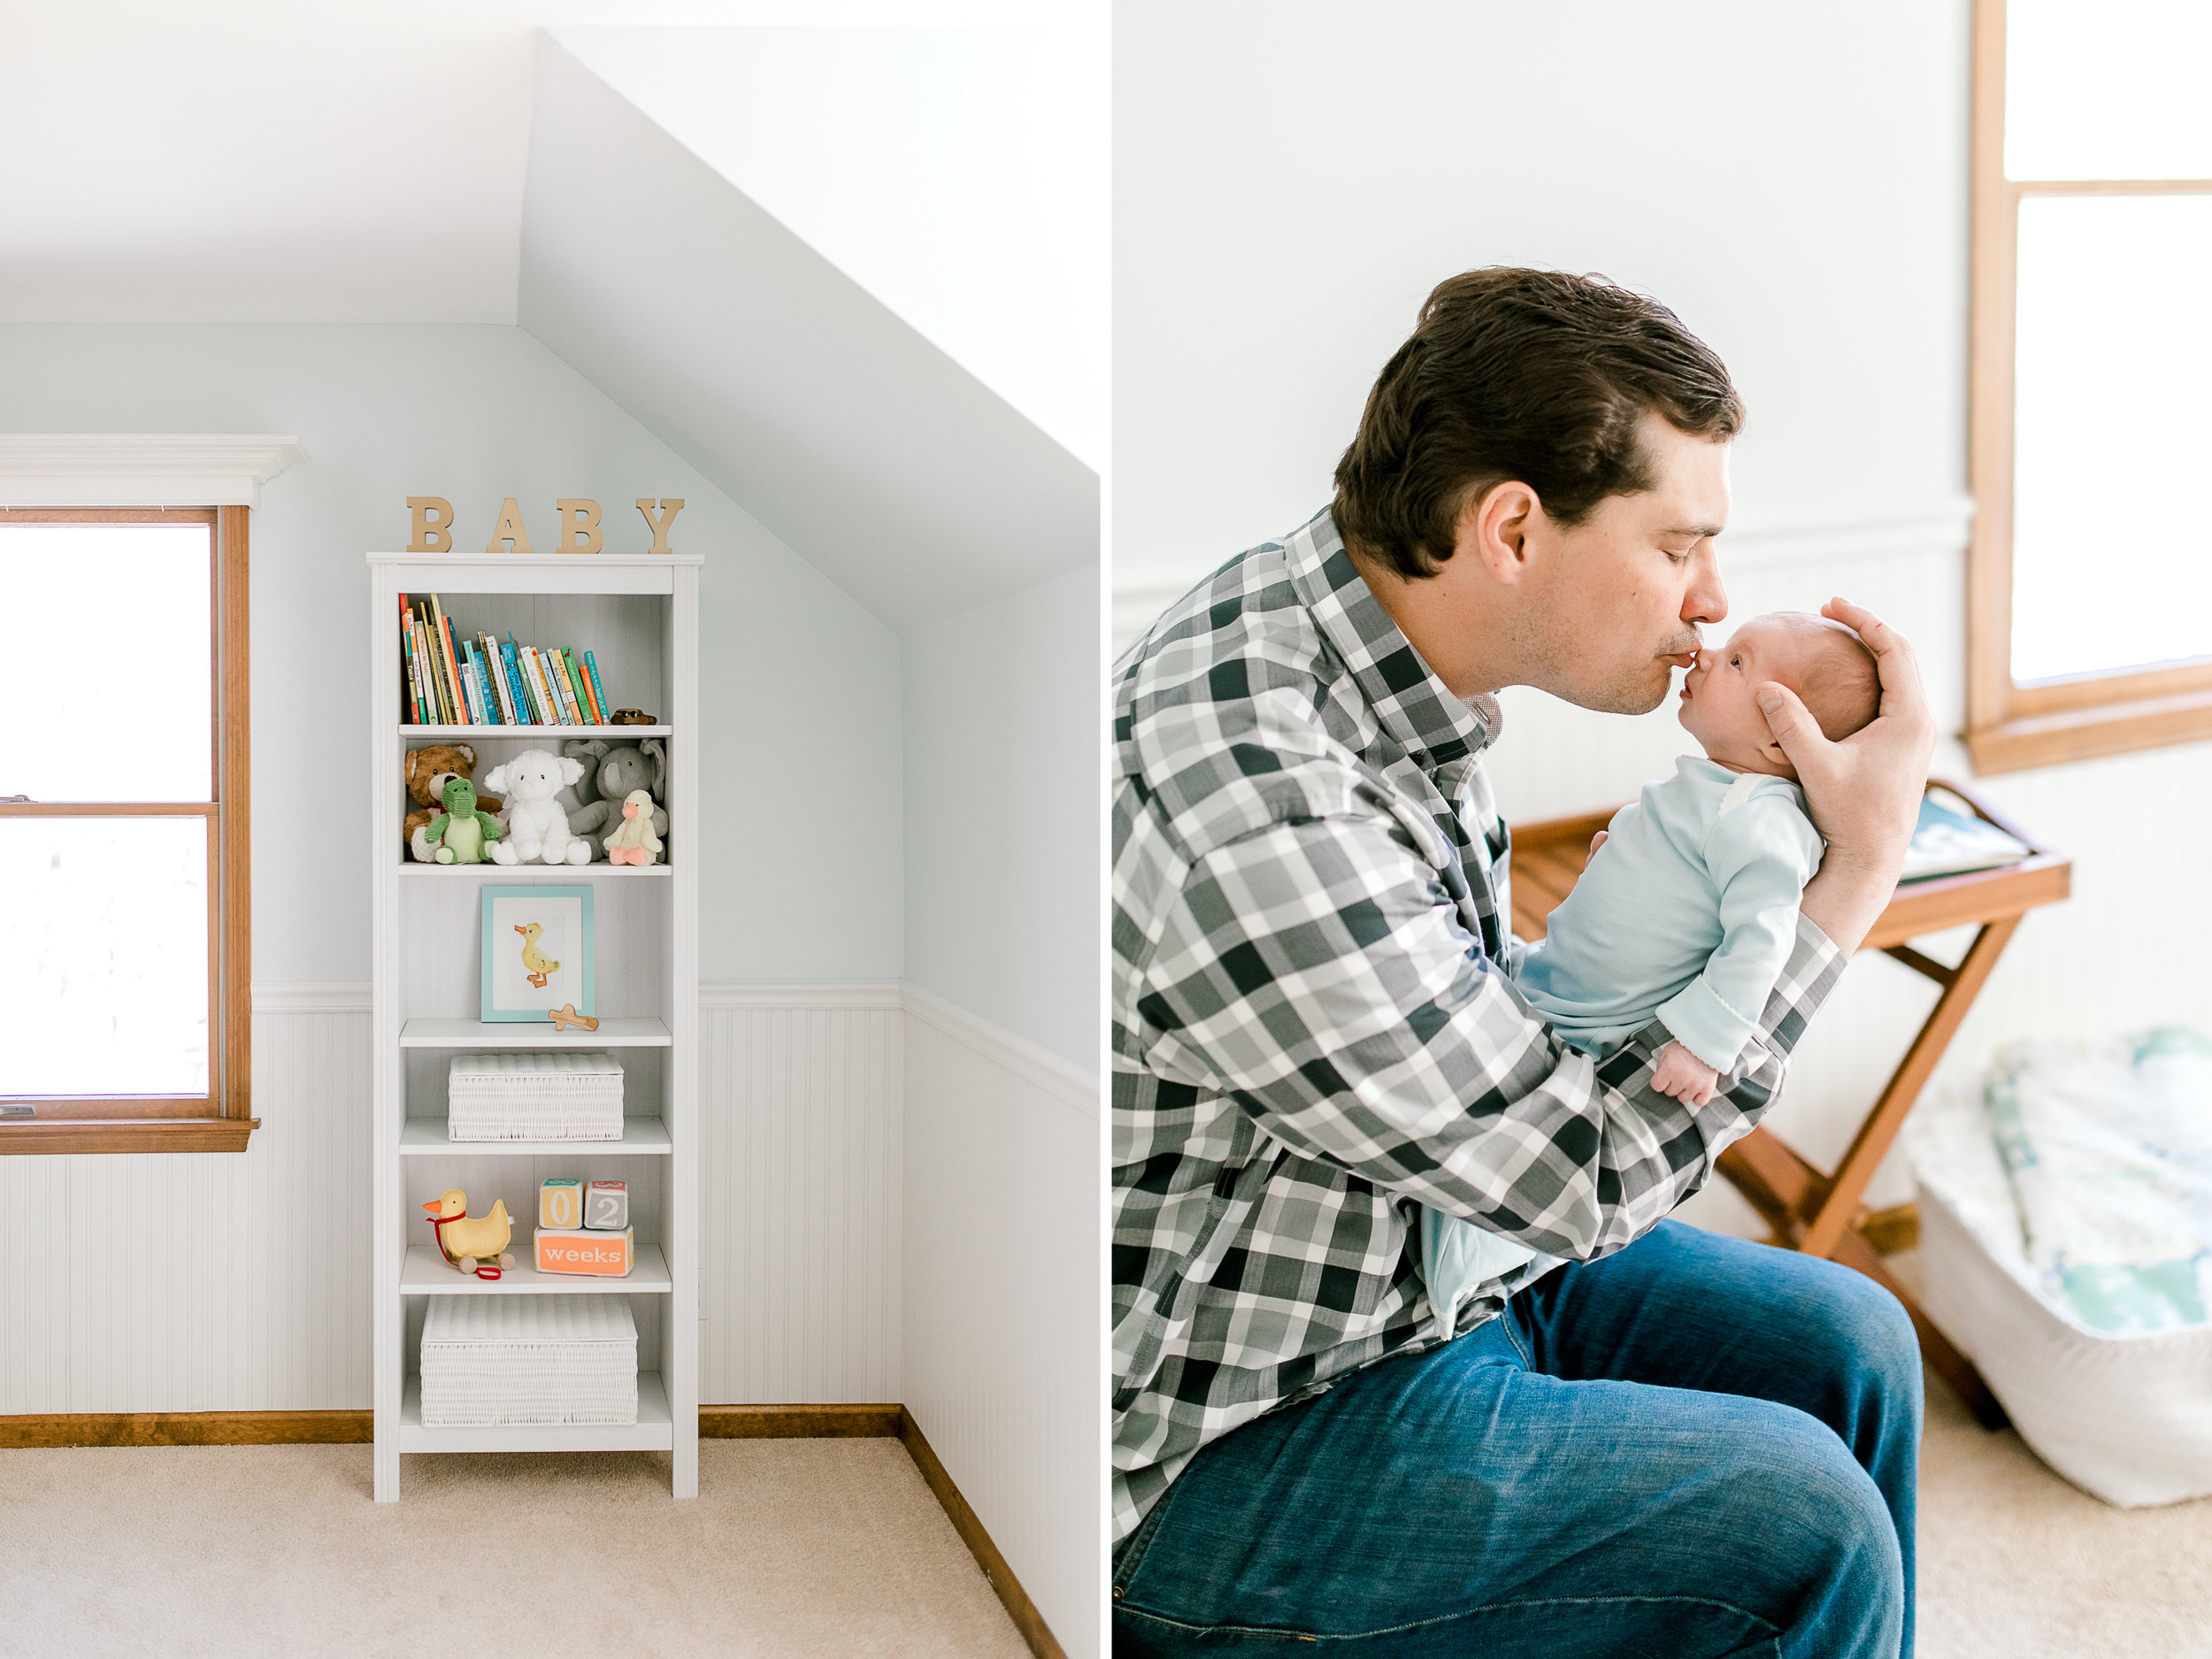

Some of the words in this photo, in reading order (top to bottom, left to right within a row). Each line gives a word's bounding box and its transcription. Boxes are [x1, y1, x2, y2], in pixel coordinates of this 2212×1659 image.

[406, 496, 685, 554] BABY
[550, 1190, 570, 1225] 0
[595, 1197, 618, 1225] 2
[545, 1248, 621, 1263] weeks
